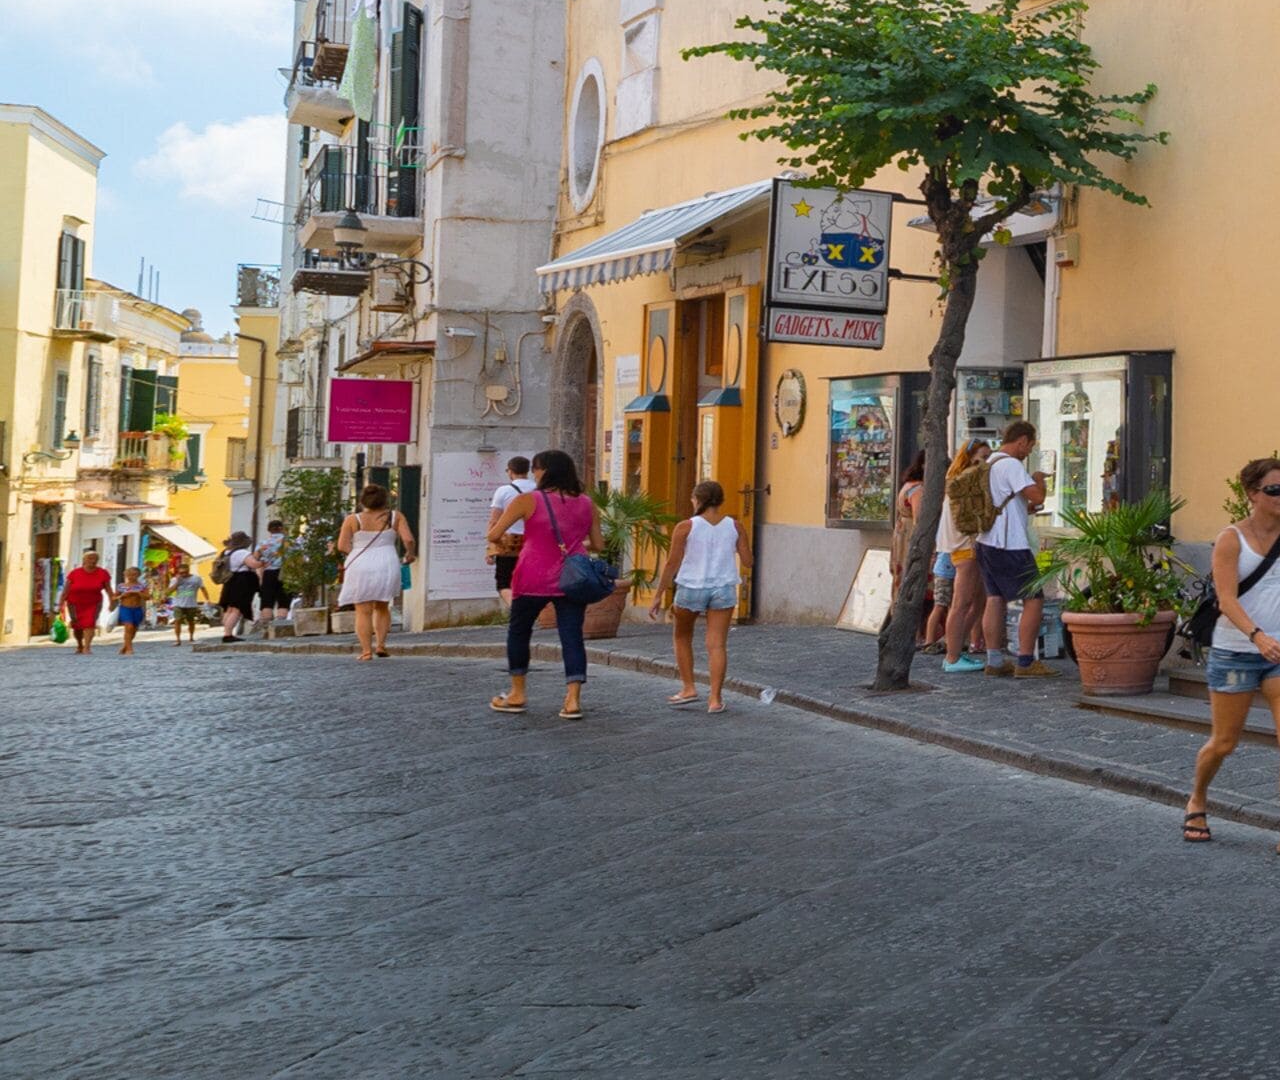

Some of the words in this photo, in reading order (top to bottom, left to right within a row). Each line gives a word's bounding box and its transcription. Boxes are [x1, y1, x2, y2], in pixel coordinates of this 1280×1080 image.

[783, 267, 879, 297] EXESS
[775, 314, 833, 337] GADGETS
[841, 319, 881, 340] MUSIC
